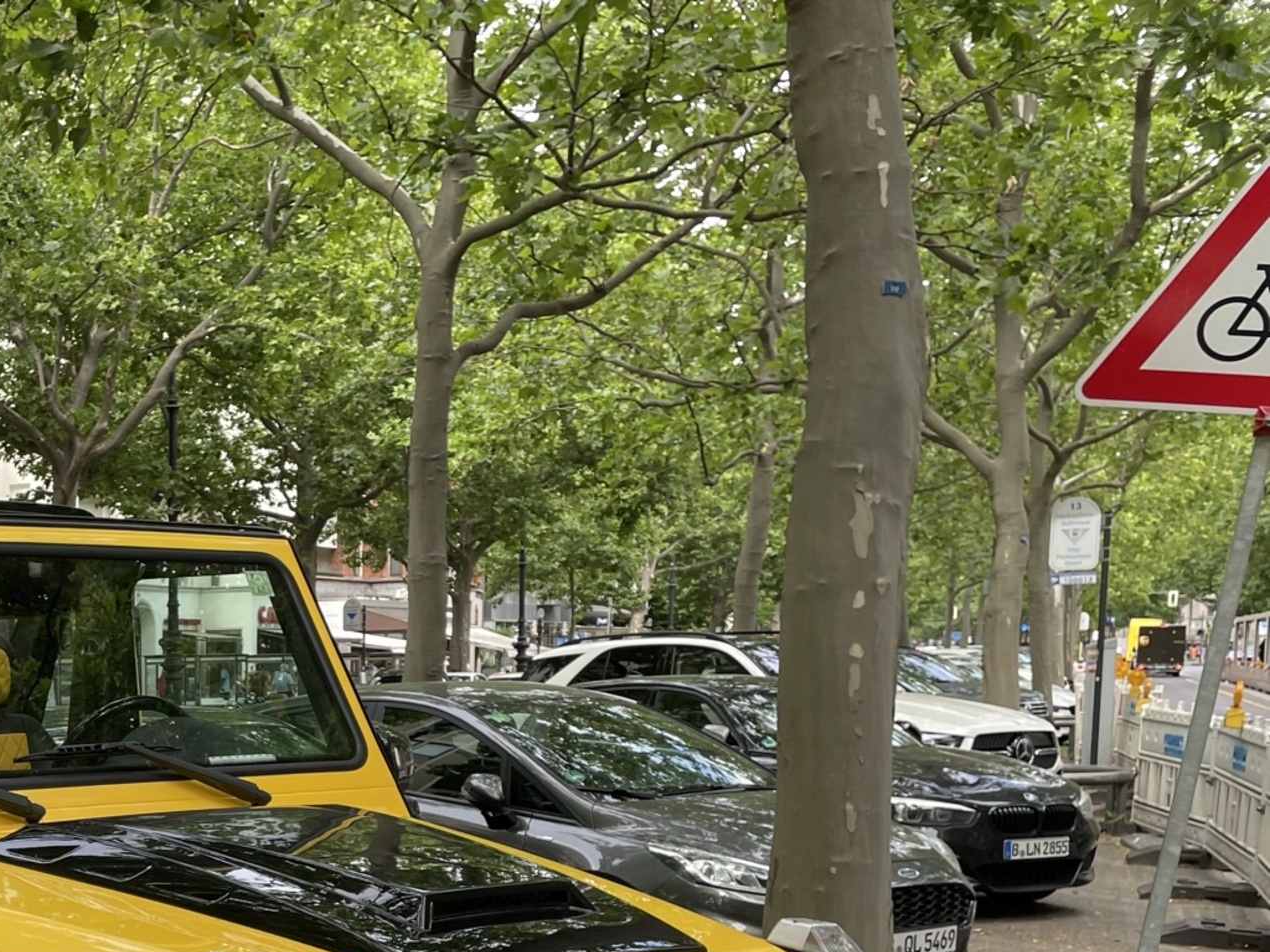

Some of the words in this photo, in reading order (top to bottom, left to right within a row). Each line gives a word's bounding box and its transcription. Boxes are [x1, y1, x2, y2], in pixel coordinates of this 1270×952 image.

[1012, 843, 1019, 856] B
[1026, 842, 1041, 856] LN
[1043, 841, 1068, 855] 2855
[925, 929, 955, 952] 5469
